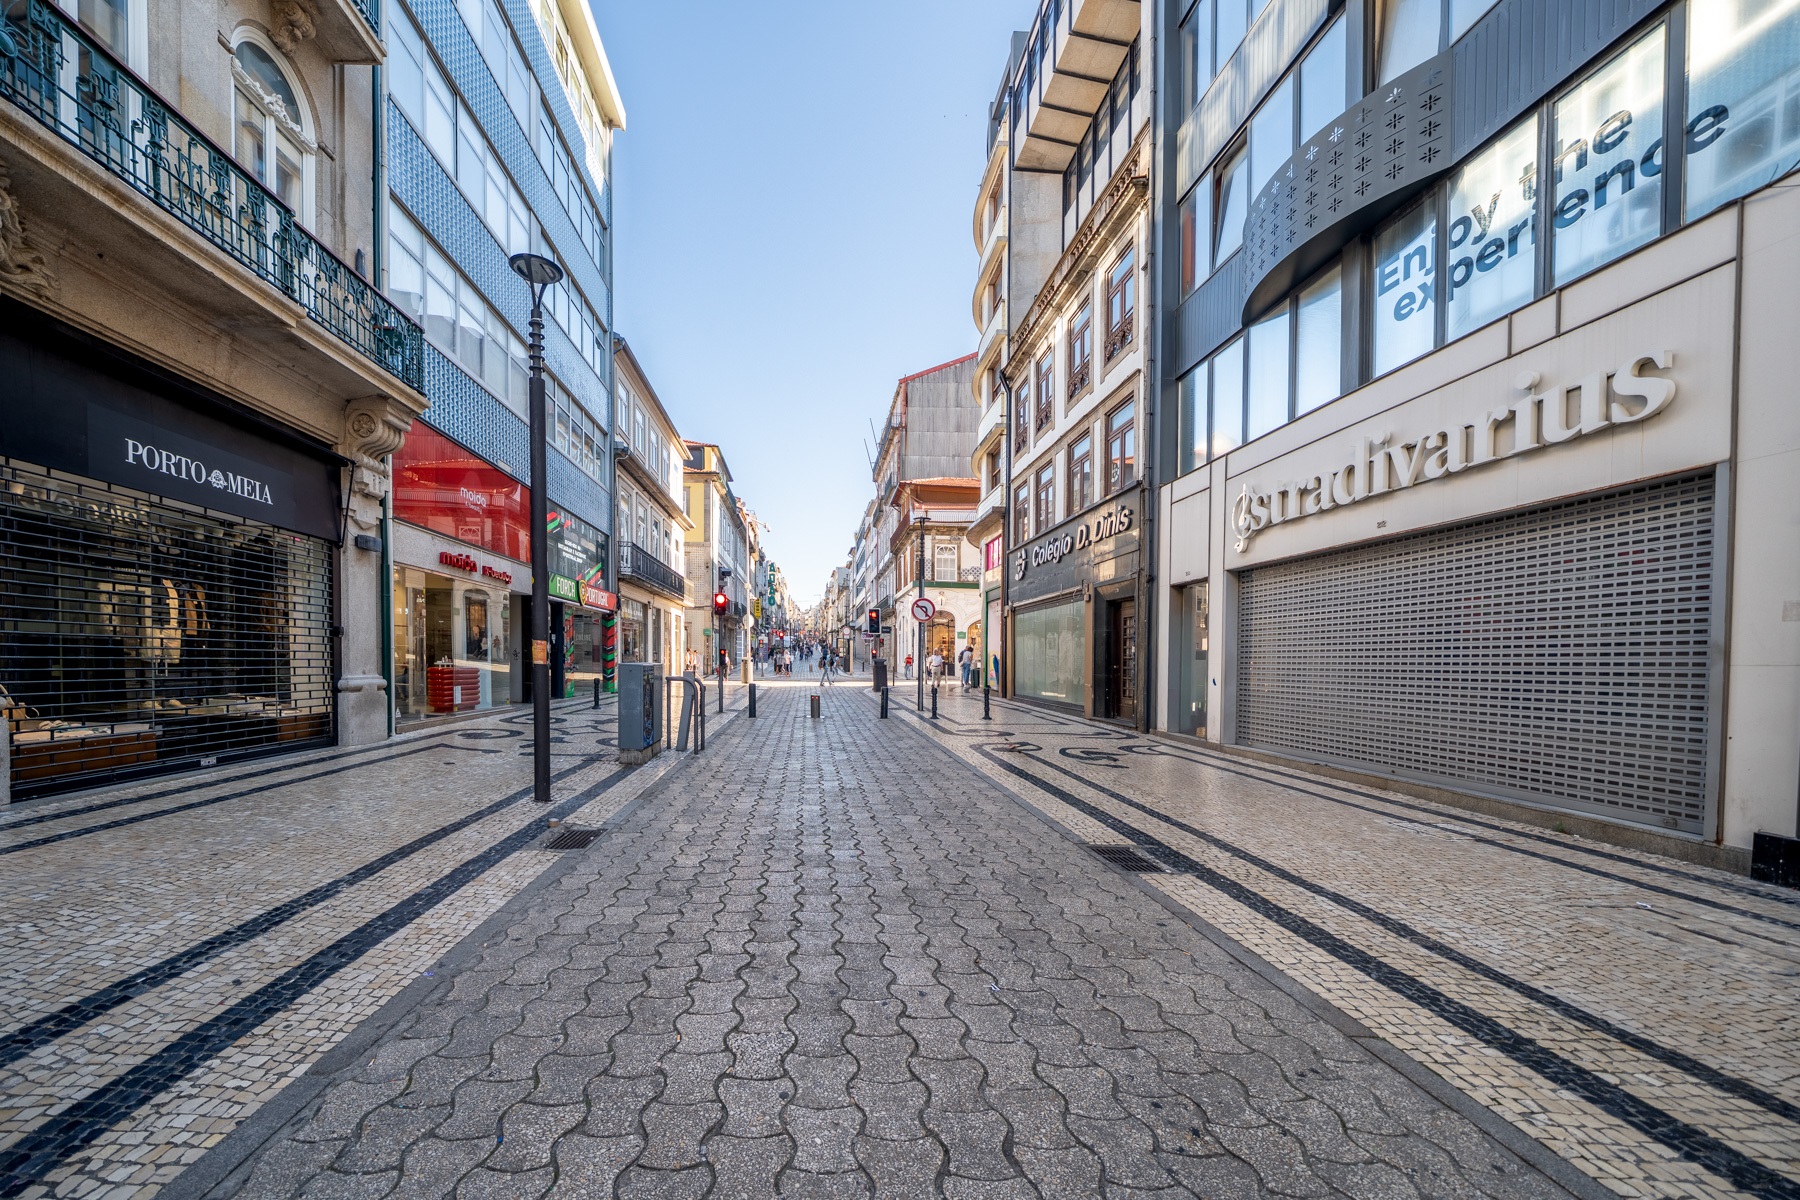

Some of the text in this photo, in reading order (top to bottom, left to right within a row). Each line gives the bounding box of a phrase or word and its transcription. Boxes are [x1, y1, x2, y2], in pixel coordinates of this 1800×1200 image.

[1378, 109, 1633, 297] Enjoy the
[1393, 104, 1730, 322] experience
[125, 438, 273, 505] PORTO MEIA
[460, 487, 487, 508] moida
[439, 552, 477, 573] moida
[1032, 505, 1133, 567] Colégio D. Dinis
[556, 577, 609, 607] FORÇA PORTUGAL
